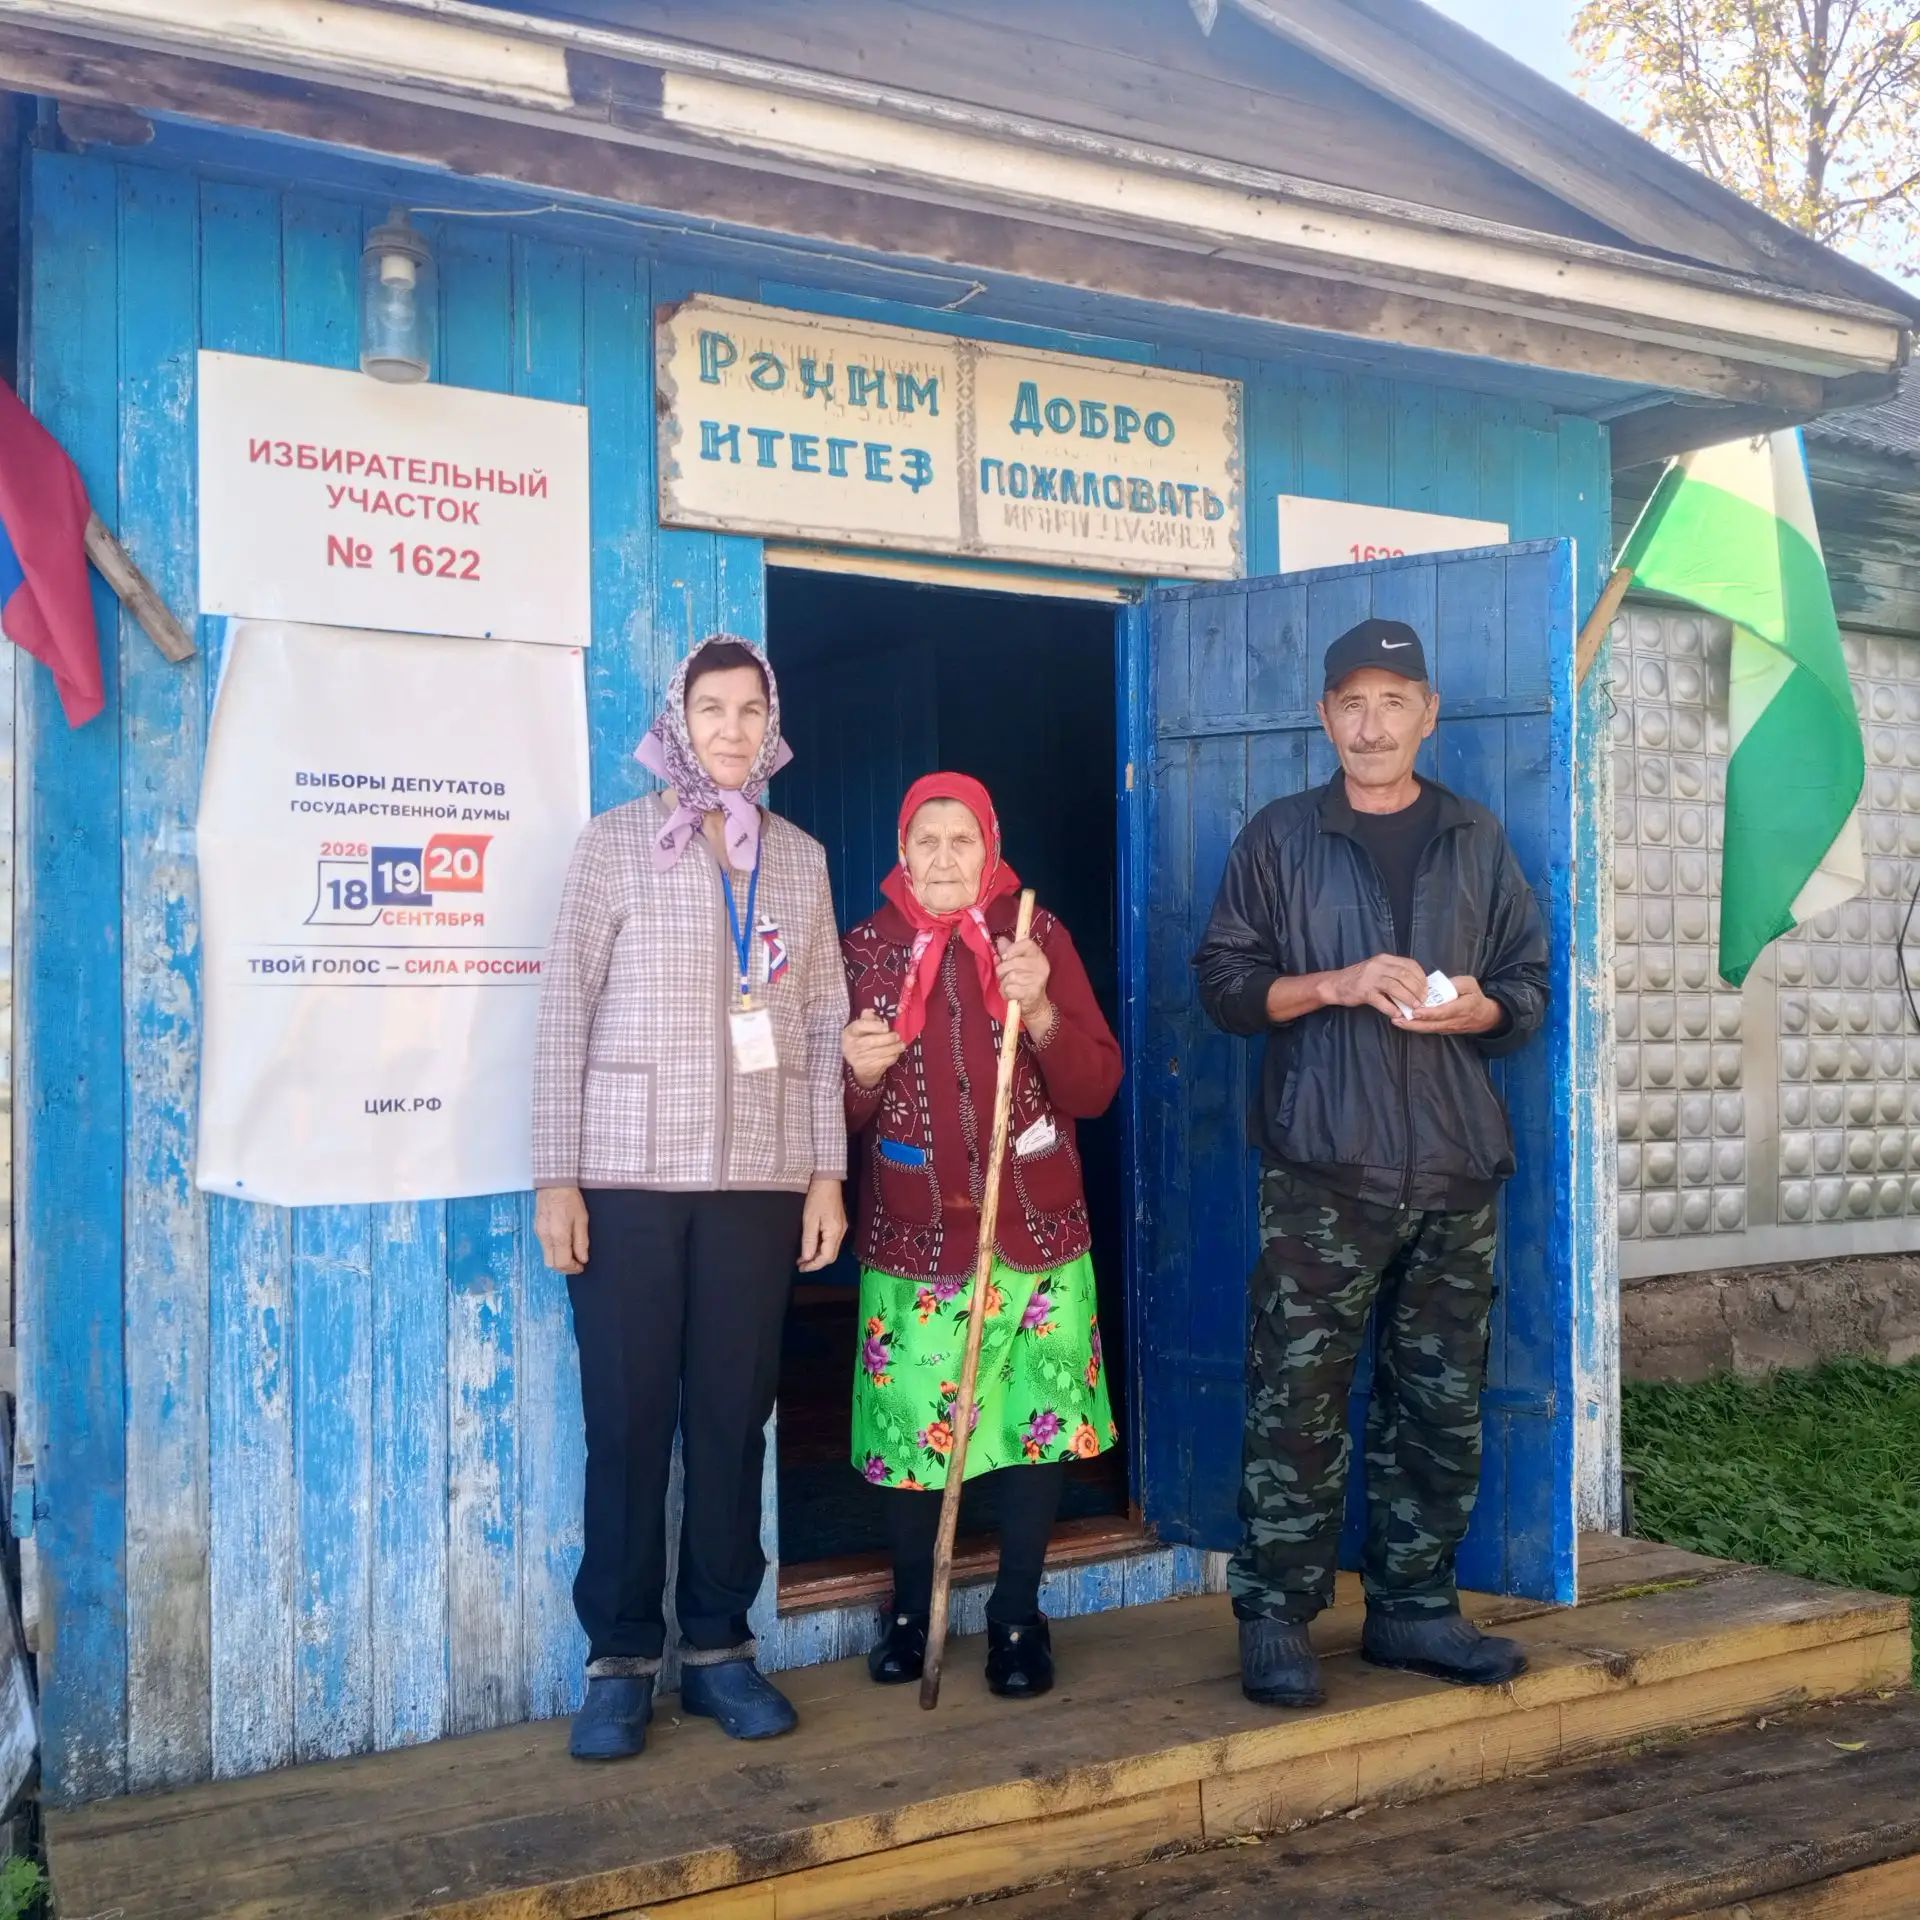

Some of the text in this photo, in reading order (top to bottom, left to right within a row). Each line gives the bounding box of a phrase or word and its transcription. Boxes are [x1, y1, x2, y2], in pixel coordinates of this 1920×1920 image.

[1009, 380, 1176, 447] ДОБРО
[249, 438, 548, 499] ИЗБИРАТЕЛЬНЫЙ
[979, 456, 1225, 521] ПОЖАЛОВАТЬ
[326, 484, 480, 525] УЧАСТОК
[327, 534, 481, 581] № 1622
[1350, 543, 1404, 563] 16
[295, 772, 506, 797] ВЫБОРЫ ДЕПУТАТОВ
[290, 800, 510, 821] ГОСУДАРСТВЕННОЙ ДУМЫ
[320, 842, 368, 857] 2026
[326, 847, 479, 911] 18 19 20
[382, 911, 485, 927] СЕНТЯБРЯ
[248, 956, 305, 974] ТВОЙ
[312, 959, 380, 974] ГОЛОС
[405, 959, 459, 974] СИЛА
[464, 959, 541, 974] РОССИИ
[364, 1097, 442, 1116] ЦИК.РФ
